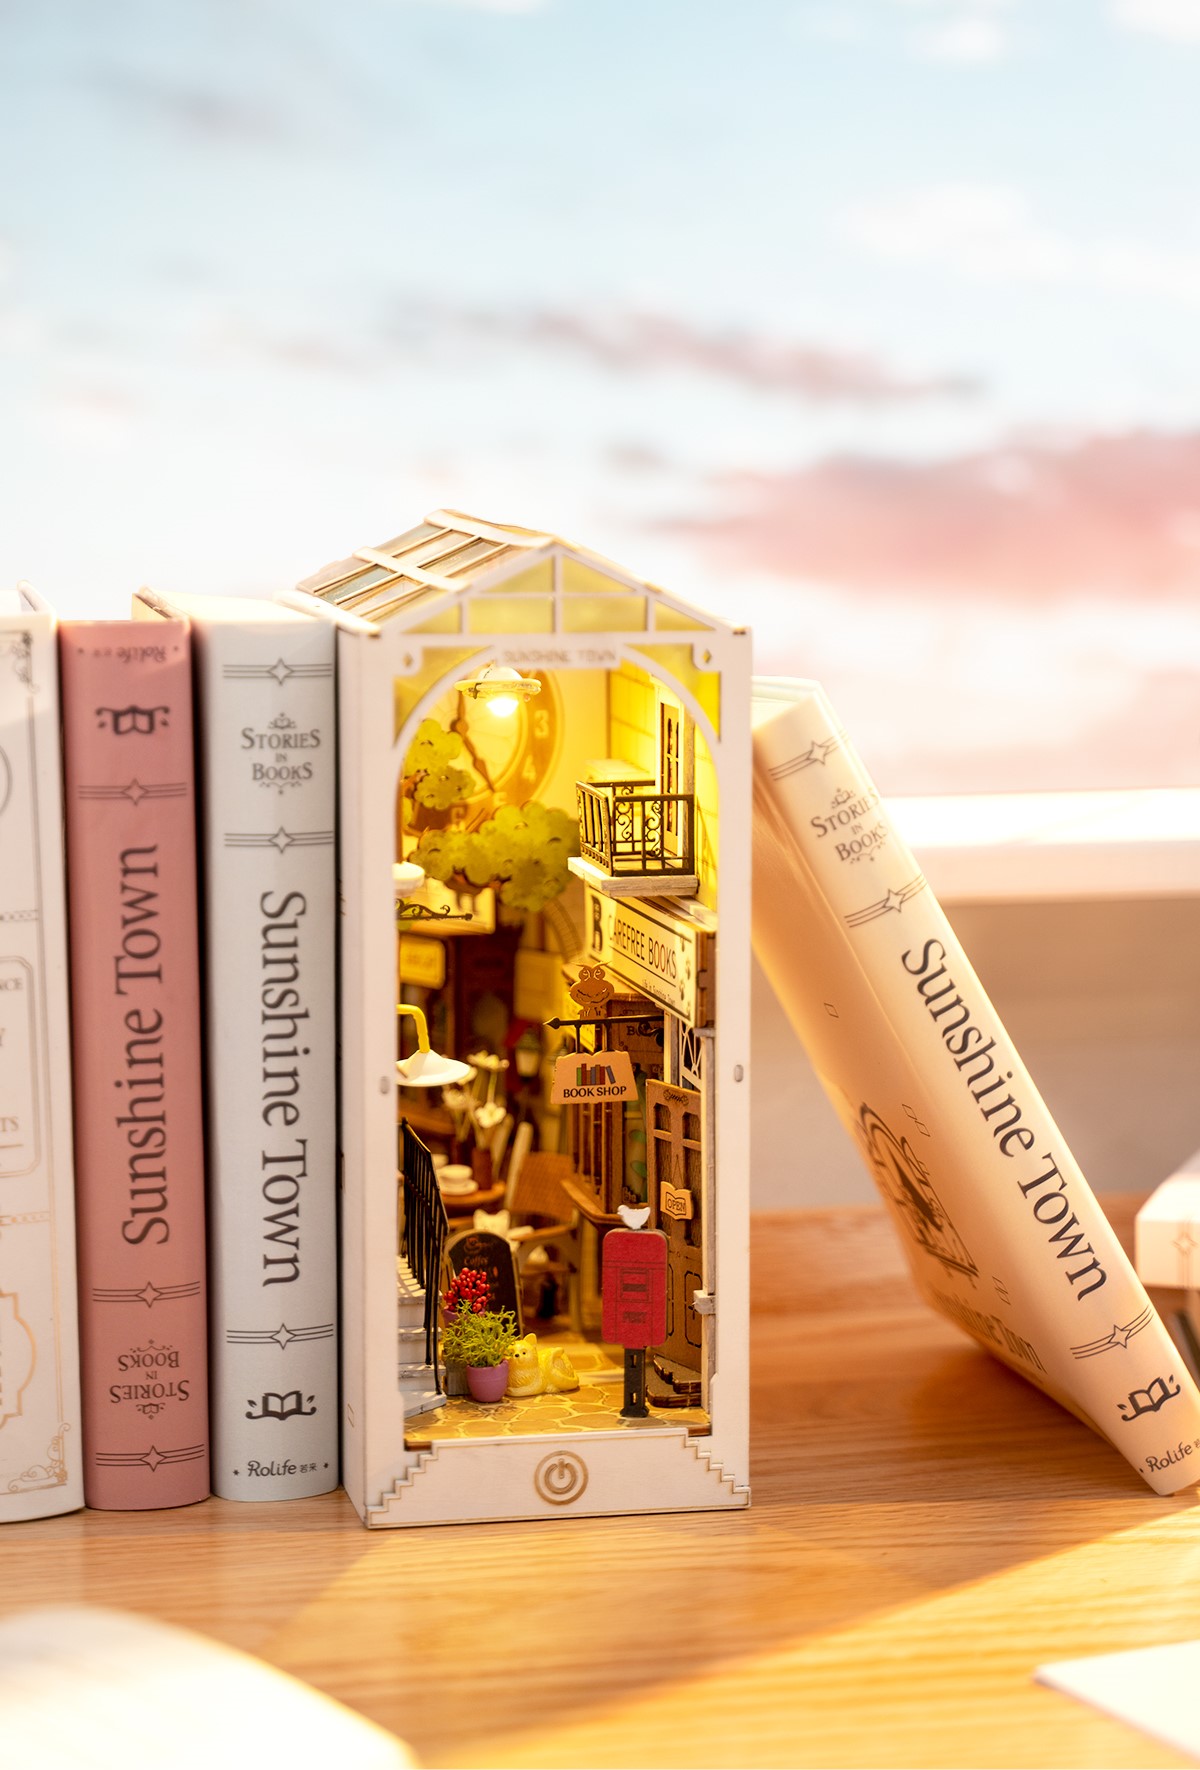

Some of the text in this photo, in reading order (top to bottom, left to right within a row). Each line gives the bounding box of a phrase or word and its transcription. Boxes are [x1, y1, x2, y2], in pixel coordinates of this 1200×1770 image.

[241, 727, 321, 750] STORIES
[275, 753, 287, 762] IN
[252, 761, 313, 781] BOOKS
[834, 821, 888, 861] BOOKS
[648, 936, 677, 980] BOOKS
[114, 844, 170, 1246] Sunshine Town
[259, 890, 311, 1288] Sunshine Town
[563, 1085, 627, 1098] BOOK SHOP
[901, 938, 1035, 1158] Sunshine
[1017, 1151, 1108, 1302] Town
[667, 1198, 687, 1213] OPEN
[117, 1350, 180, 1372] BOOKS
[145, 1370, 158, 1380] IN
[109, 1379, 190, 1404] STORIES
[247, 1459, 298, 1477] Rolife
[1145, 1441, 1193, 1472] Rolife
